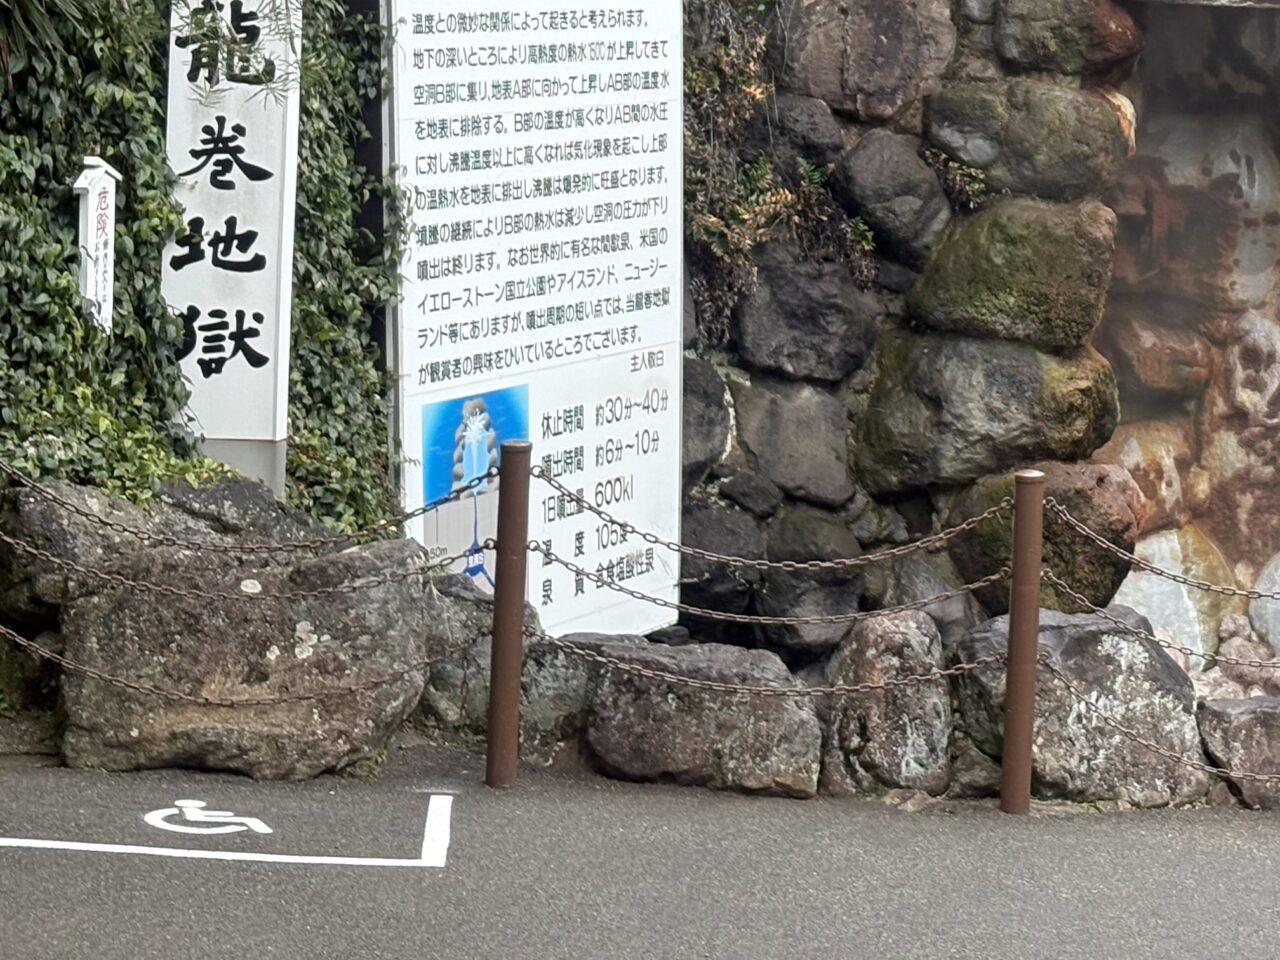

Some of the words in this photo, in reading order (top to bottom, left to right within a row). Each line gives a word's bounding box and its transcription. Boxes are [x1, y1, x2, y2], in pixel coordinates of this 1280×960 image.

[96, 186, 109, 239] 危険
[541, 404, 584, 440] 休止時間
